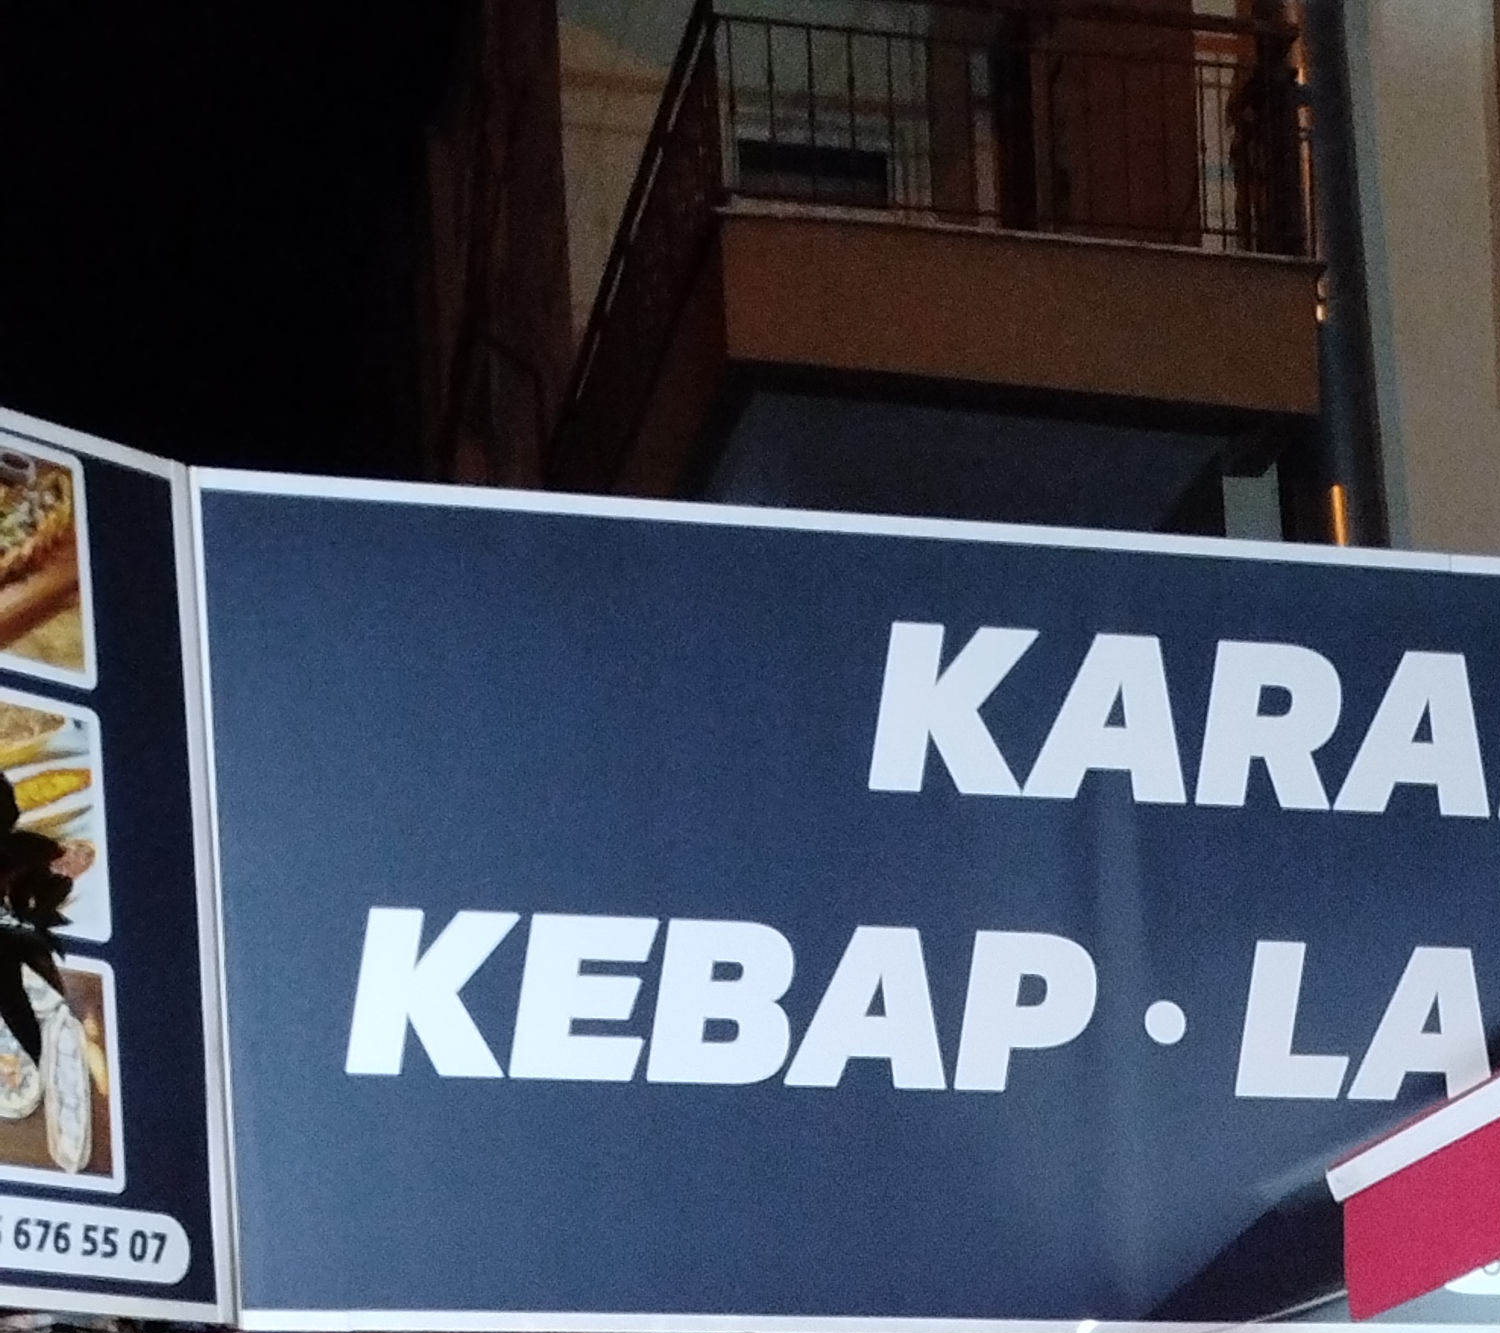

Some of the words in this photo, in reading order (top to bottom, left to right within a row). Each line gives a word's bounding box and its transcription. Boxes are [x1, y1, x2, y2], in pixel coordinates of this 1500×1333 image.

[344, 906, 1098, 1093] KEBAP
[14, 1216, 71, 1254] 676
[81, 1223, 119, 1258] 55
[129, 1229, 167, 1264] 07
